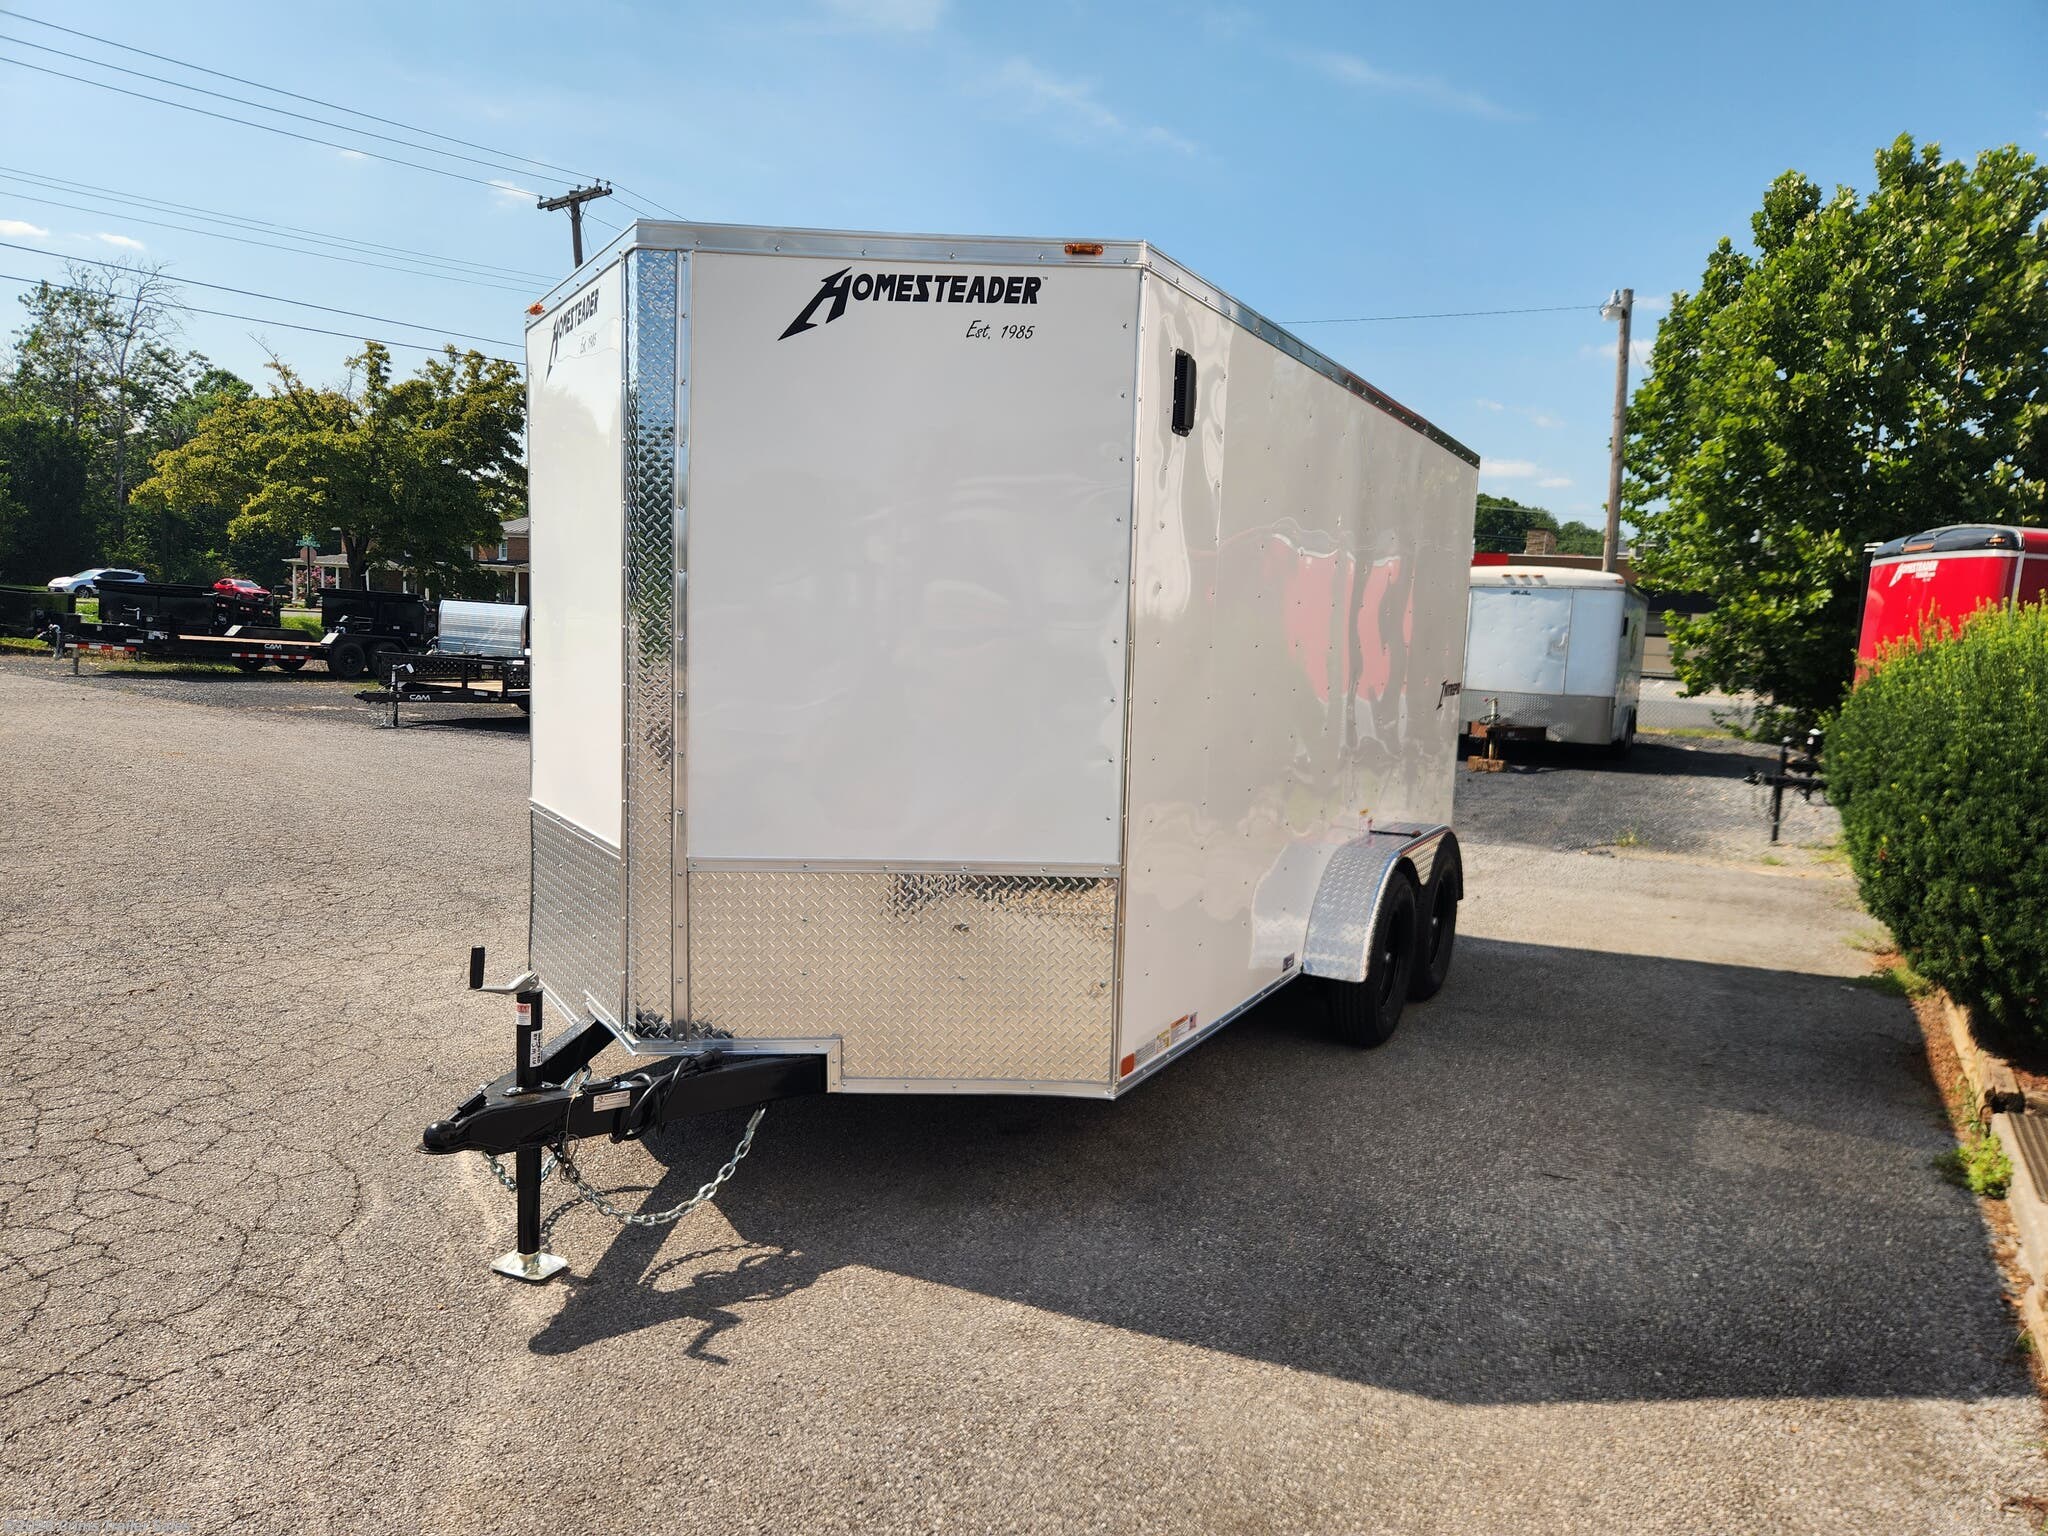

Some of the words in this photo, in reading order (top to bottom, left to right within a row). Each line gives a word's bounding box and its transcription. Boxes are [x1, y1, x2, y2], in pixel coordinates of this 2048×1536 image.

[777, 266, 1041, 341] HOMESTEADER
[965, 319, 991, 340] Est.
[999, 324, 1036, 340] 1985
